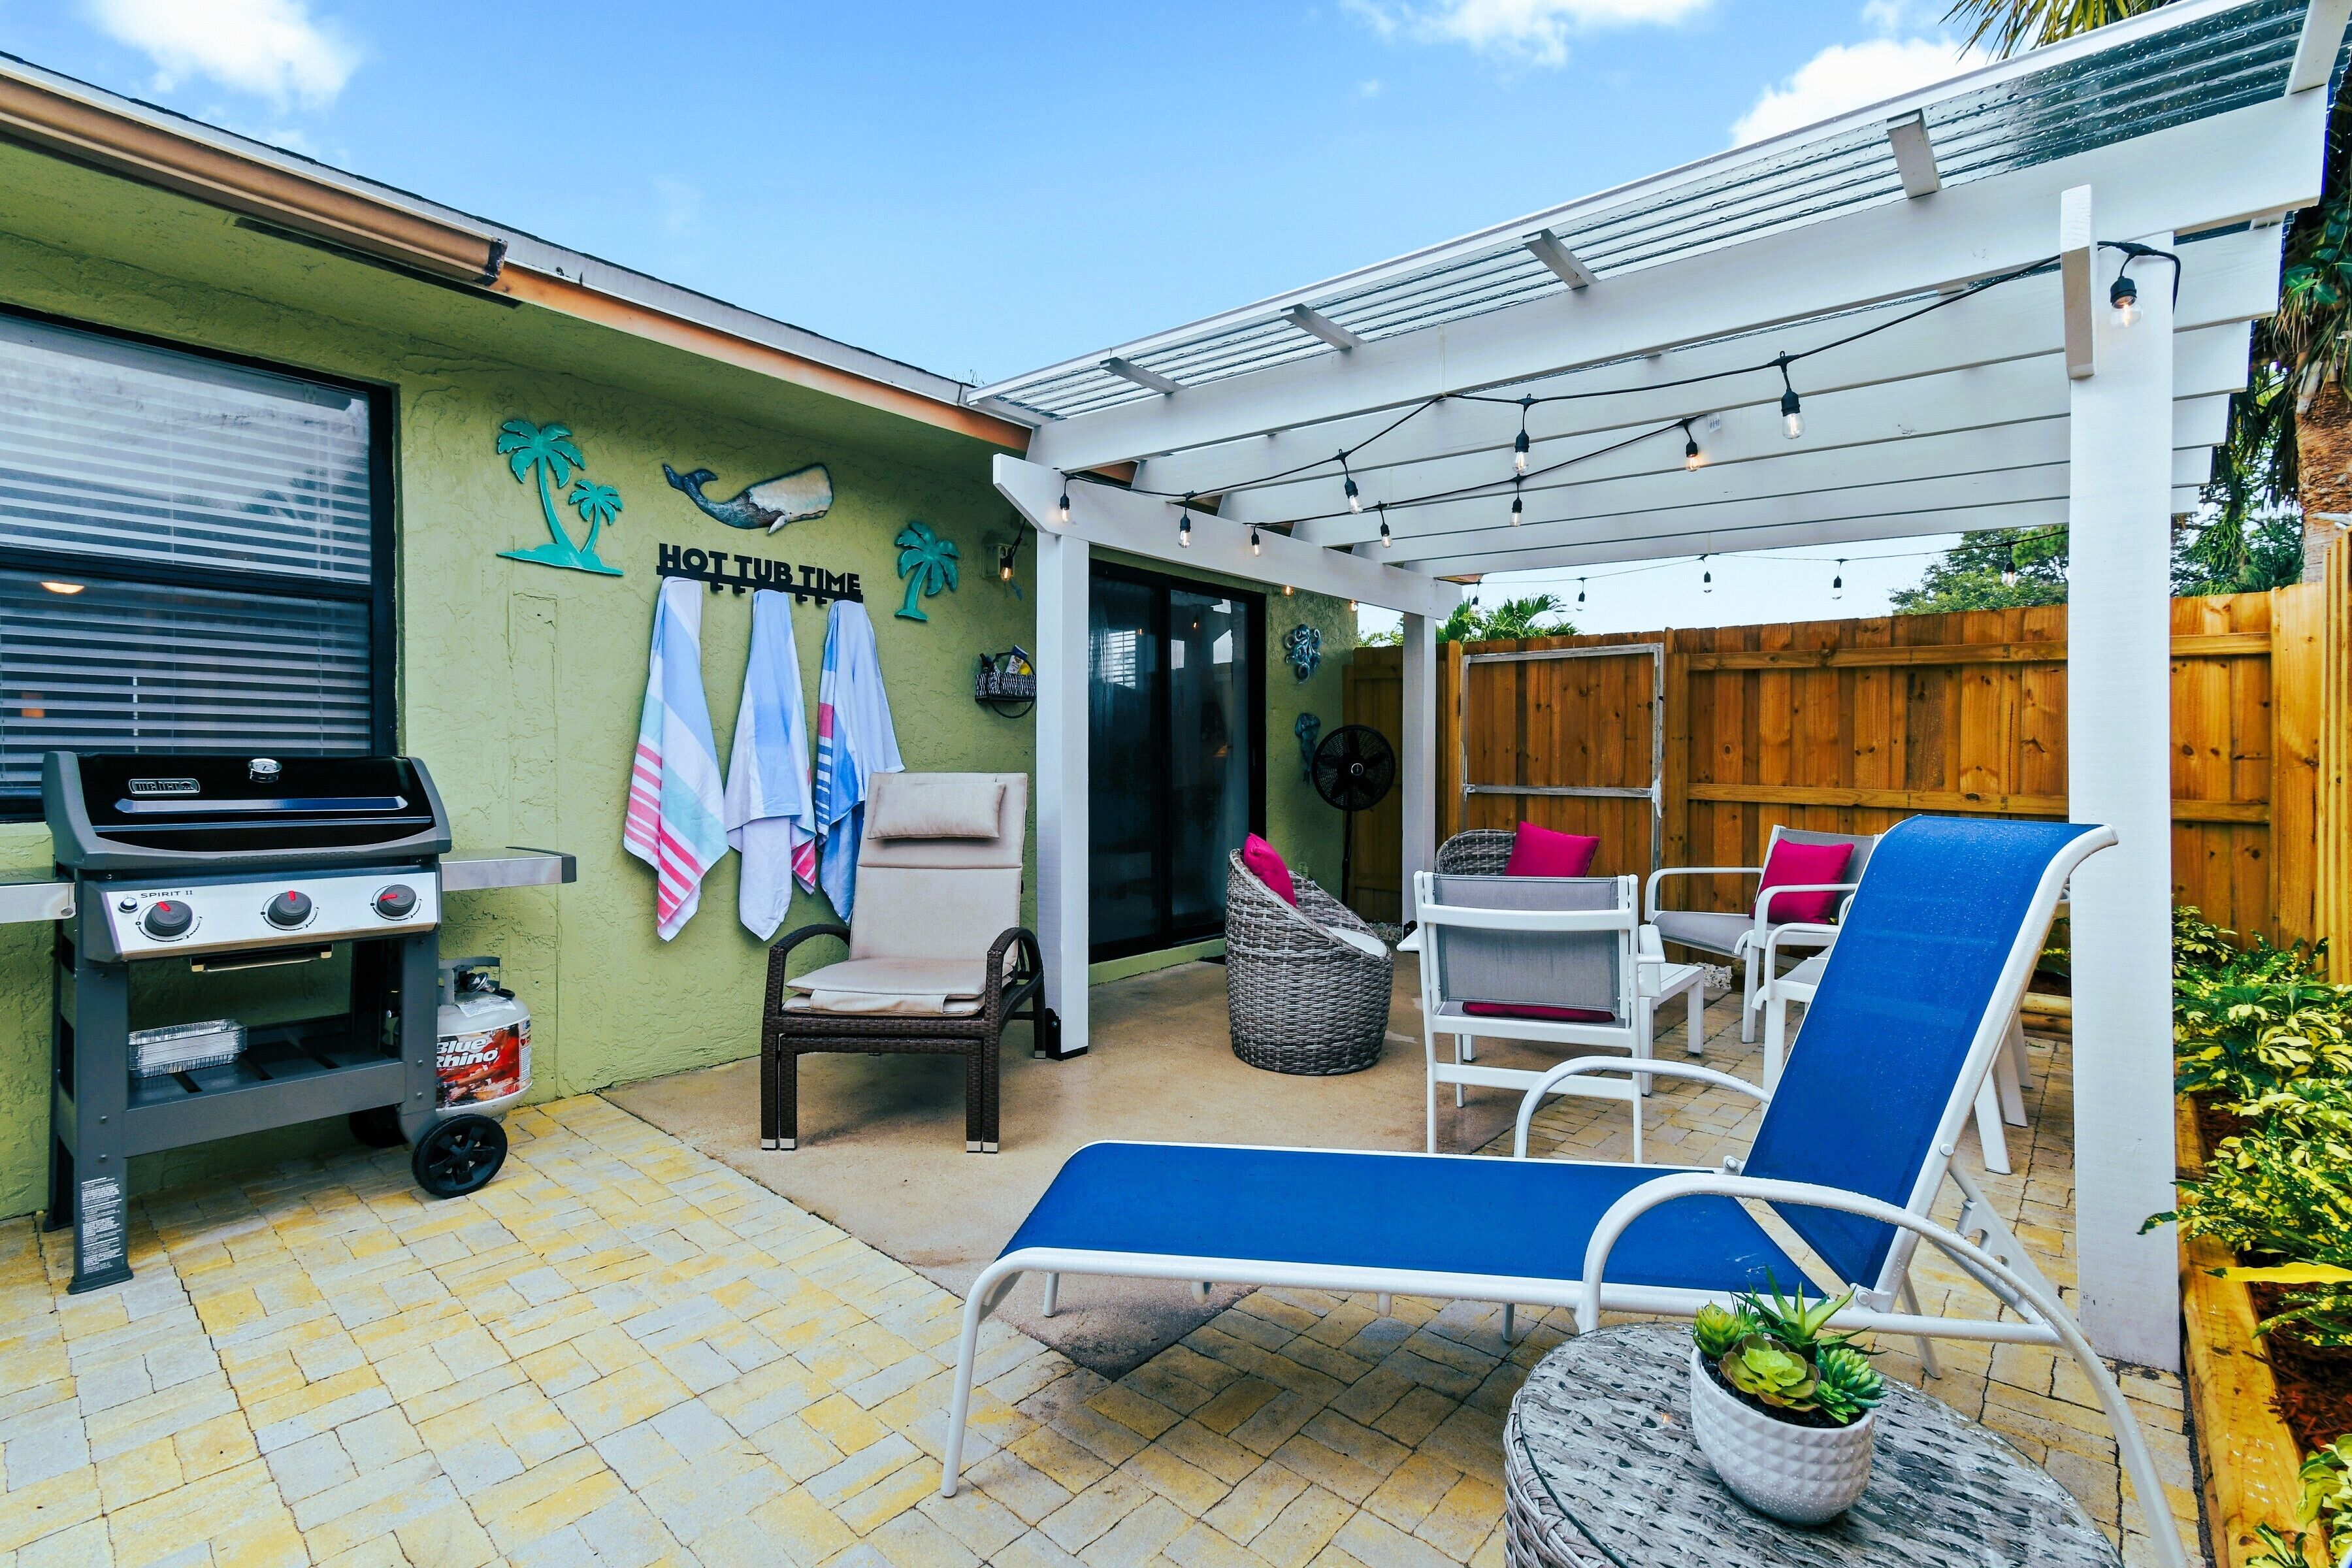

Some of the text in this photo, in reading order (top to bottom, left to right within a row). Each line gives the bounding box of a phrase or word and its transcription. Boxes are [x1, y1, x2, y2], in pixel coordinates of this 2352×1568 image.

[659, 543, 862, 596] HOT TUB TIME
[135, 781, 180, 791] weber
